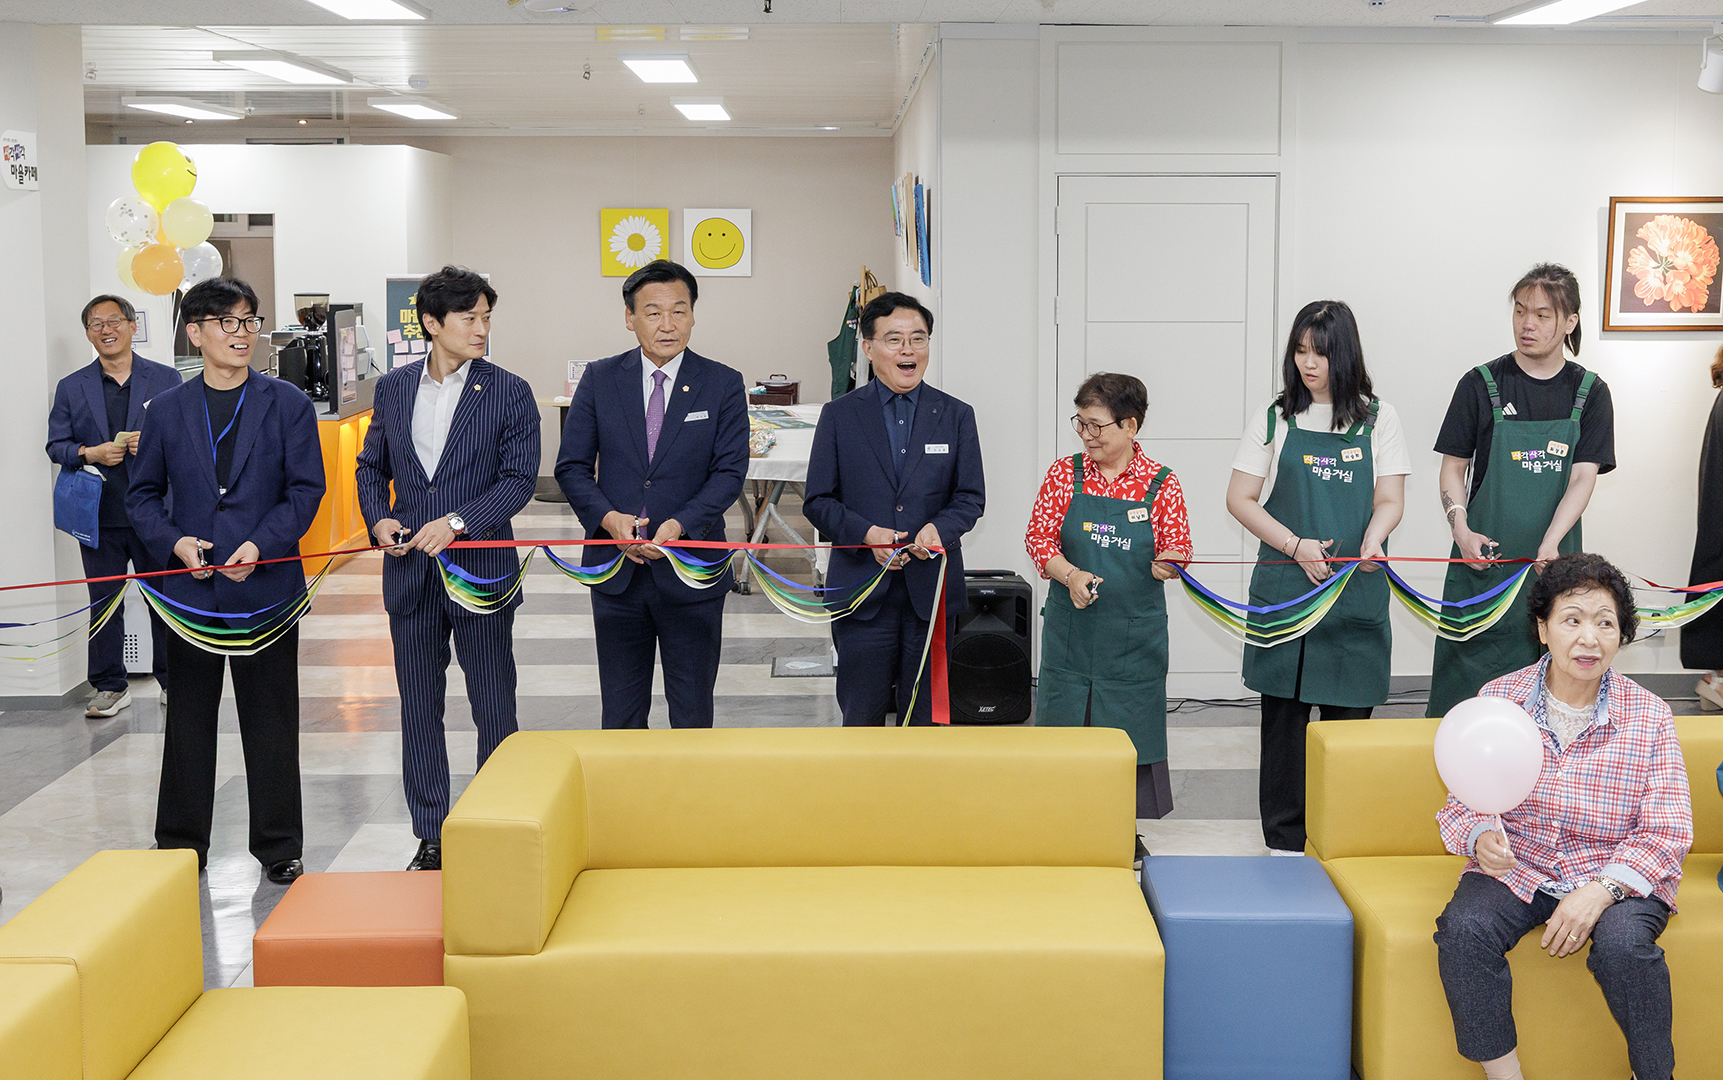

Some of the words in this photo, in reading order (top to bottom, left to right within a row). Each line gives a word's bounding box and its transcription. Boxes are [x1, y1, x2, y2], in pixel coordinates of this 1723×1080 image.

[11, 164, 38, 185] 마을카페
[1303, 454, 1337, 468] 사각사각
[1511, 449, 1546, 461] 사각사각
[1522, 460, 1562, 473] 마을거실
[1312, 466, 1353, 483] 마을거실
[1083, 521, 1116, 535] 사각사각
[1090, 533, 1132, 551] 마을거실
